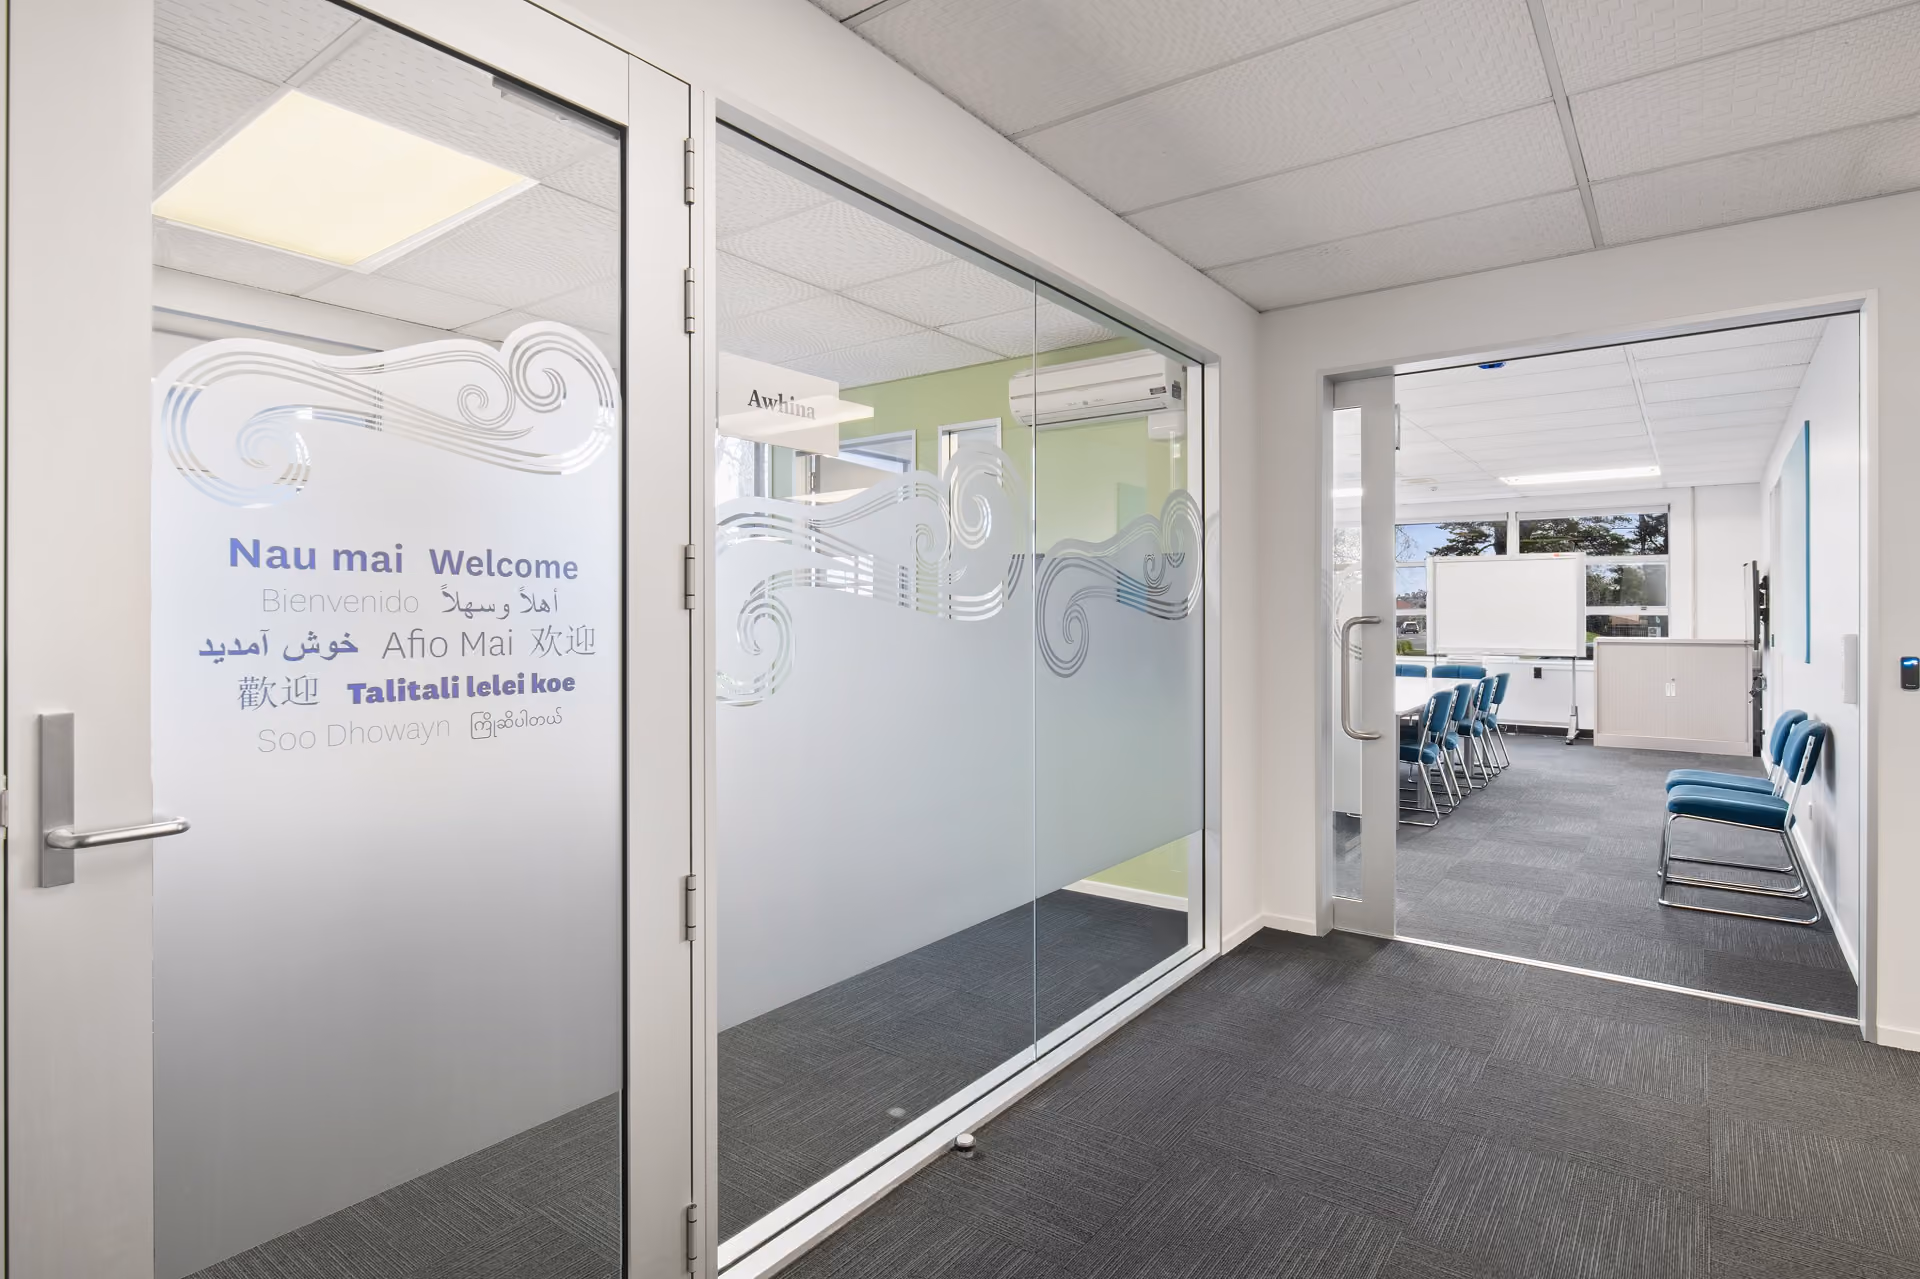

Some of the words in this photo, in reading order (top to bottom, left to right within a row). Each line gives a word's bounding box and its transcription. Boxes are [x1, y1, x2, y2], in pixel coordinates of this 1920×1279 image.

[747, 388, 816, 420] Awhina
[230, 537, 317, 571] Nau
[332, 543, 404, 574] mai
[428, 548, 579, 580] Welcome
[262, 588, 420, 614] Bienvenido
[283, 630, 359, 662] خوش
[381, 627, 449, 660] Afio
[461, 628, 513, 658] Mai
[529, 624, 597, 659] 欢迎
[237, 675, 321, 712] 歡迎
[346, 675, 460, 705] Talitali
[465, 671, 525, 699] lelei
[531, 672, 577, 694] koe
[257, 728, 317, 753] Soo
[327, 719, 450, 747] Dhowayn
